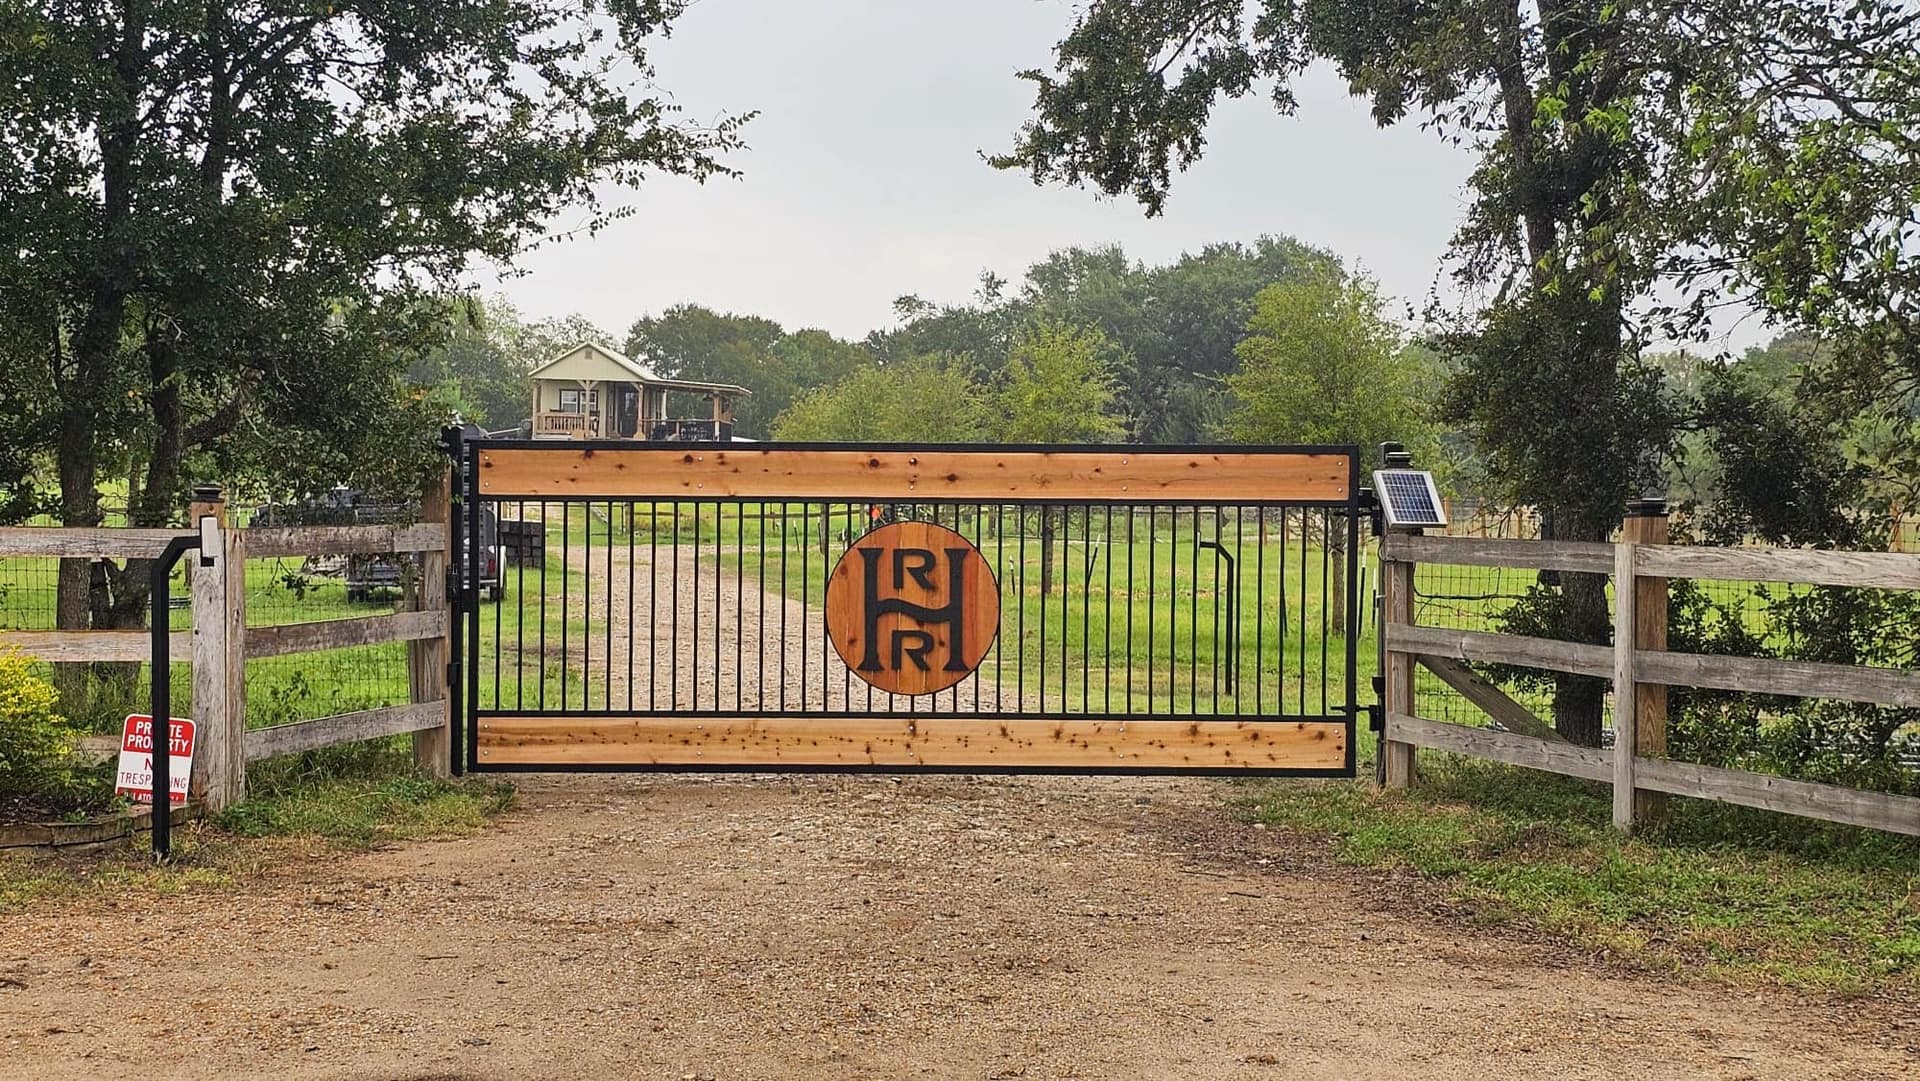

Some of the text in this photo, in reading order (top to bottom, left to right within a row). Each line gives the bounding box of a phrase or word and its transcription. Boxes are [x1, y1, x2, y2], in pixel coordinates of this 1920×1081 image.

[135, 721, 183, 738] PRTE
[127, 734, 189, 752] PRORTY
[120, 772, 187, 789] TRESPING
